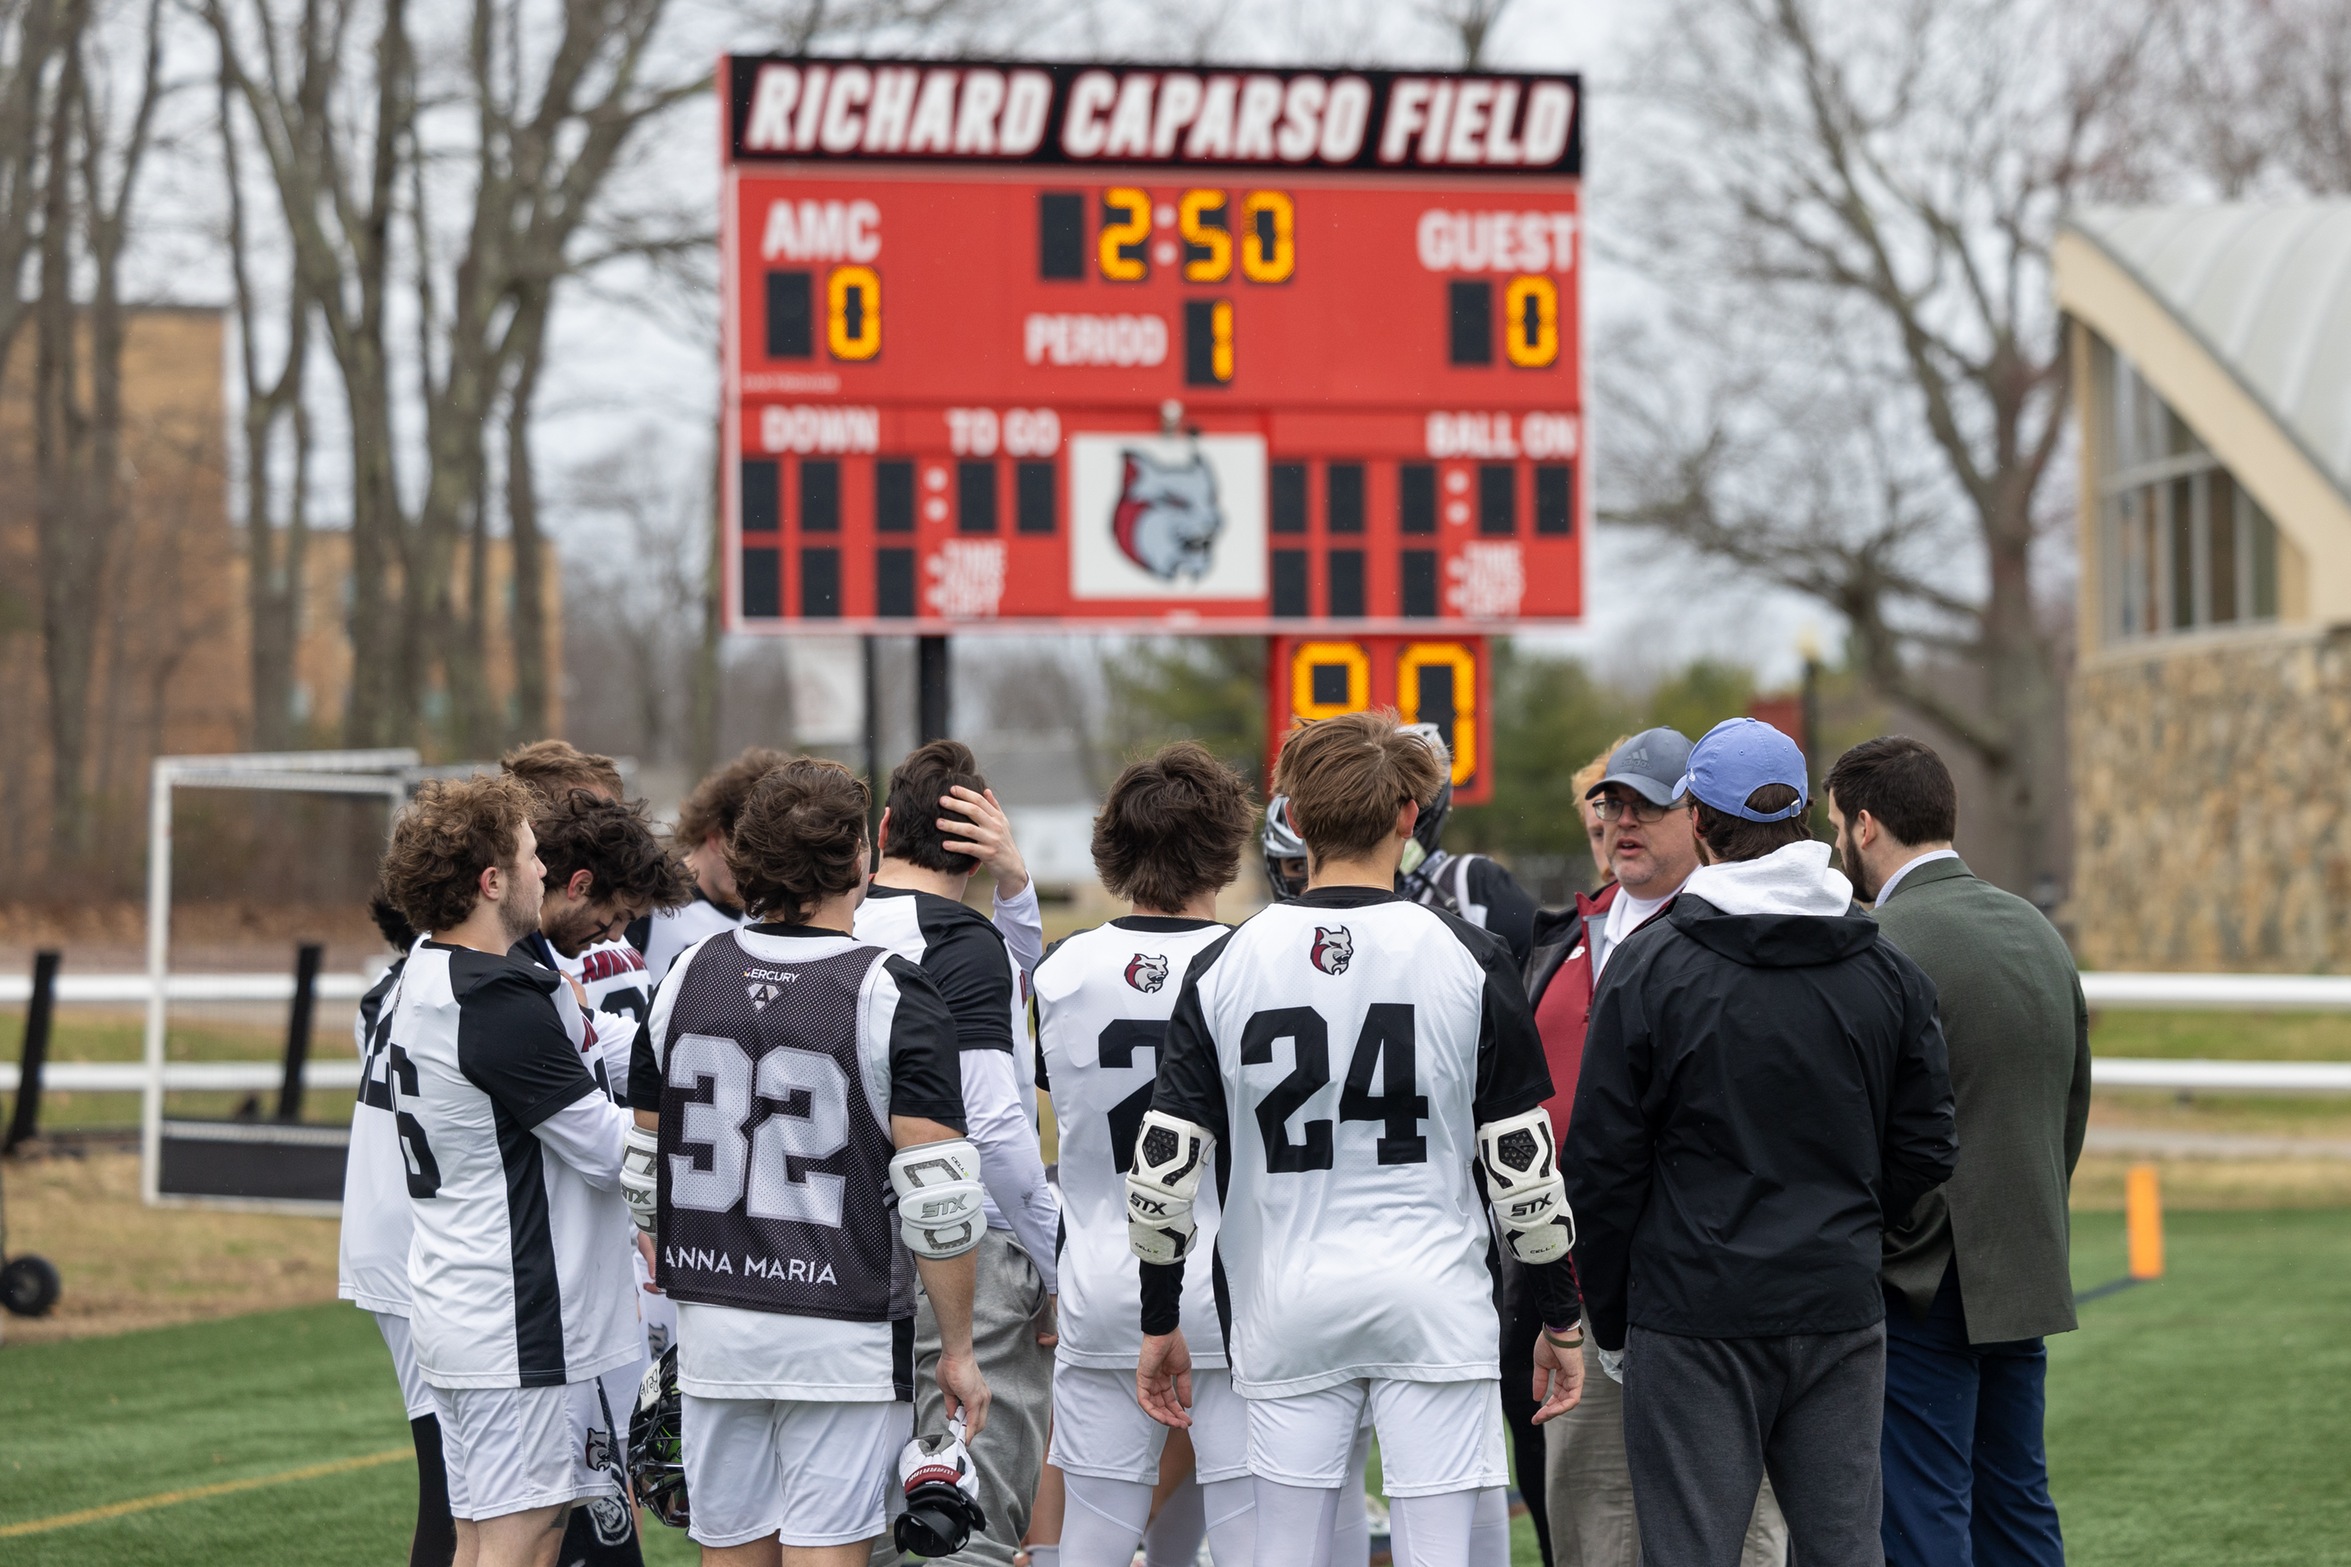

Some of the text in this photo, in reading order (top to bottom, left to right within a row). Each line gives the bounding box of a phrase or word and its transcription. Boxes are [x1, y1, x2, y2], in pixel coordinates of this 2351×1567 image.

[746, 63, 1575, 164] RICHARD CAPARSO FIELD
[762, 199, 882, 264] AMC
[1099, 186, 1295, 282] 2:50
[1416, 208, 1575, 273] GUEST
[827, 266, 882, 361] 0
[1024, 313, 1168, 367] PERIOD
[1211, 300, 1234, 382] 1
[1505, 274, 1558, 368] 0
[762, 404, 879, 454] DOWN
[944, 407, 1061, 457] TO GO
[1426, 411, 1577, 460] BALL ON
[1240, 1003, 1428, 1173] 24
[668, 1032, 850, 1228] 32
[921, 1193, 968, 1218] STX
[1129, 1191, 1167, 1215] STX
[1511, 1192, 1553, 1216] STX
[665, 1245, 837, 1286] ANNA MARIA
